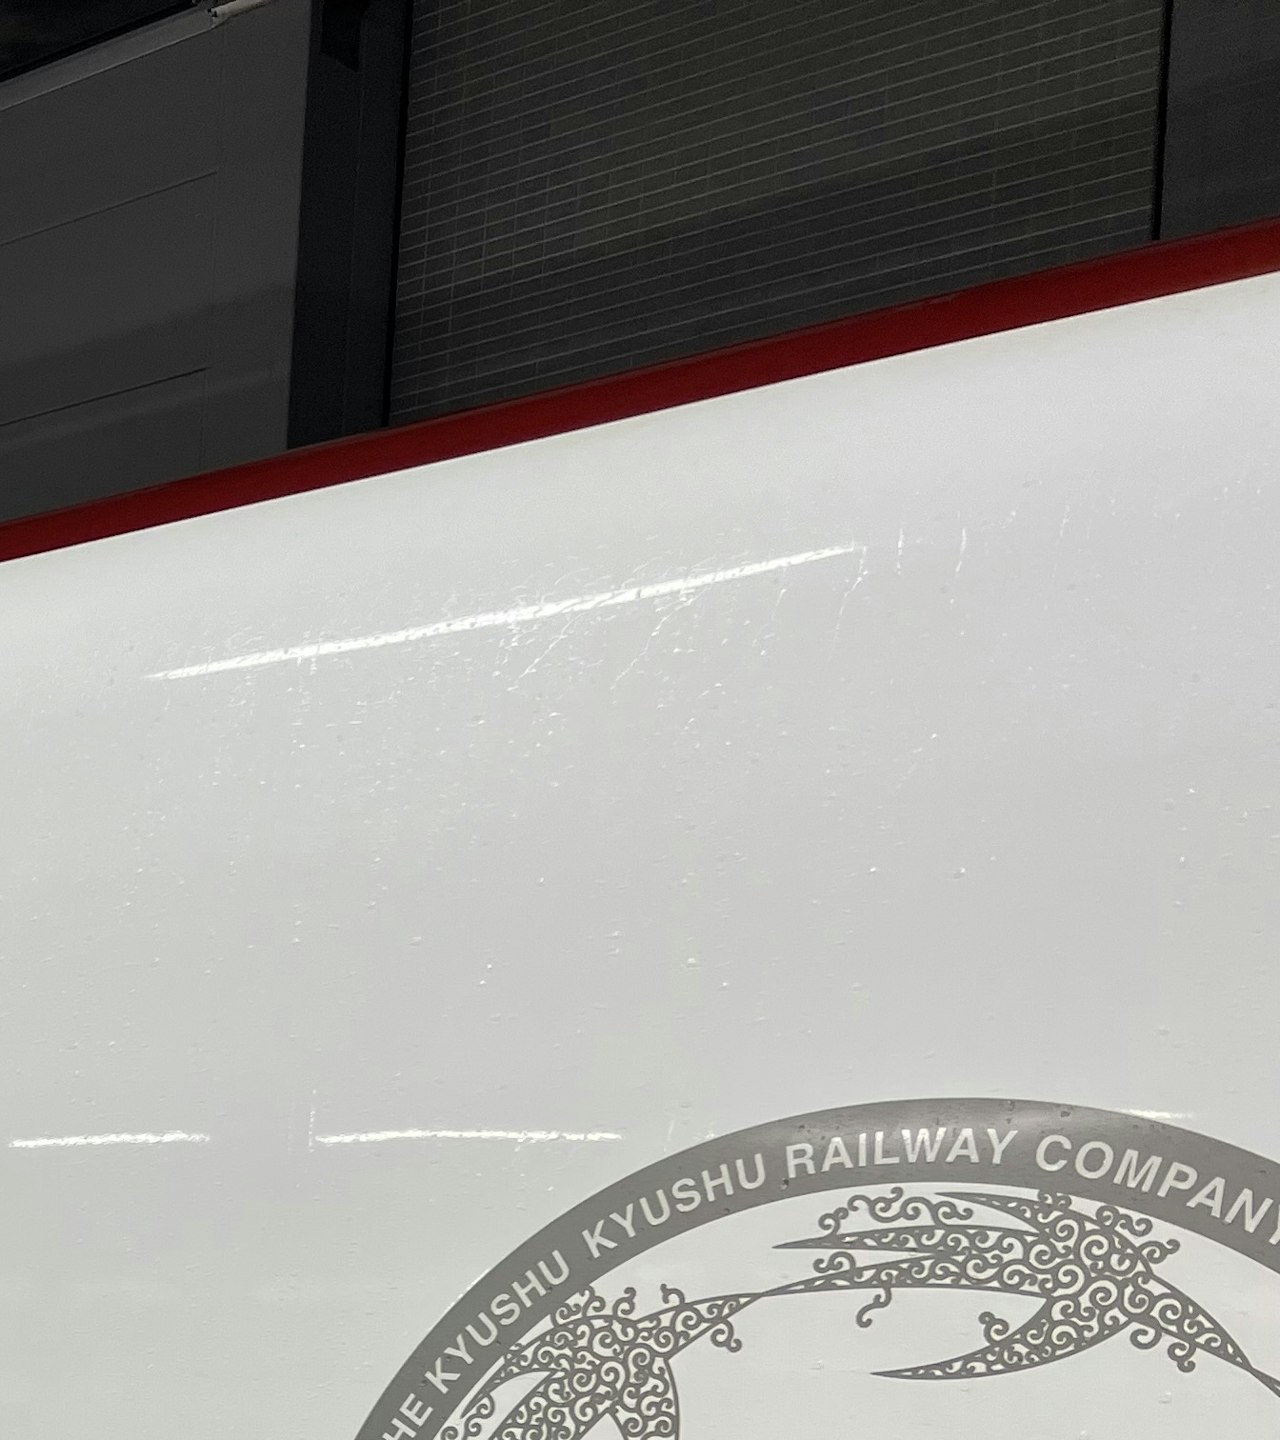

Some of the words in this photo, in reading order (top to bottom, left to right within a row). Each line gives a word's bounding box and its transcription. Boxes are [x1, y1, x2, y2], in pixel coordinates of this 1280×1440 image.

[424, 1250, 570, 1394] KYUSHU
[582, 1153, 766, 1259] KYUSHU
[786, 1127, 1018, 1179] RAILWAY
